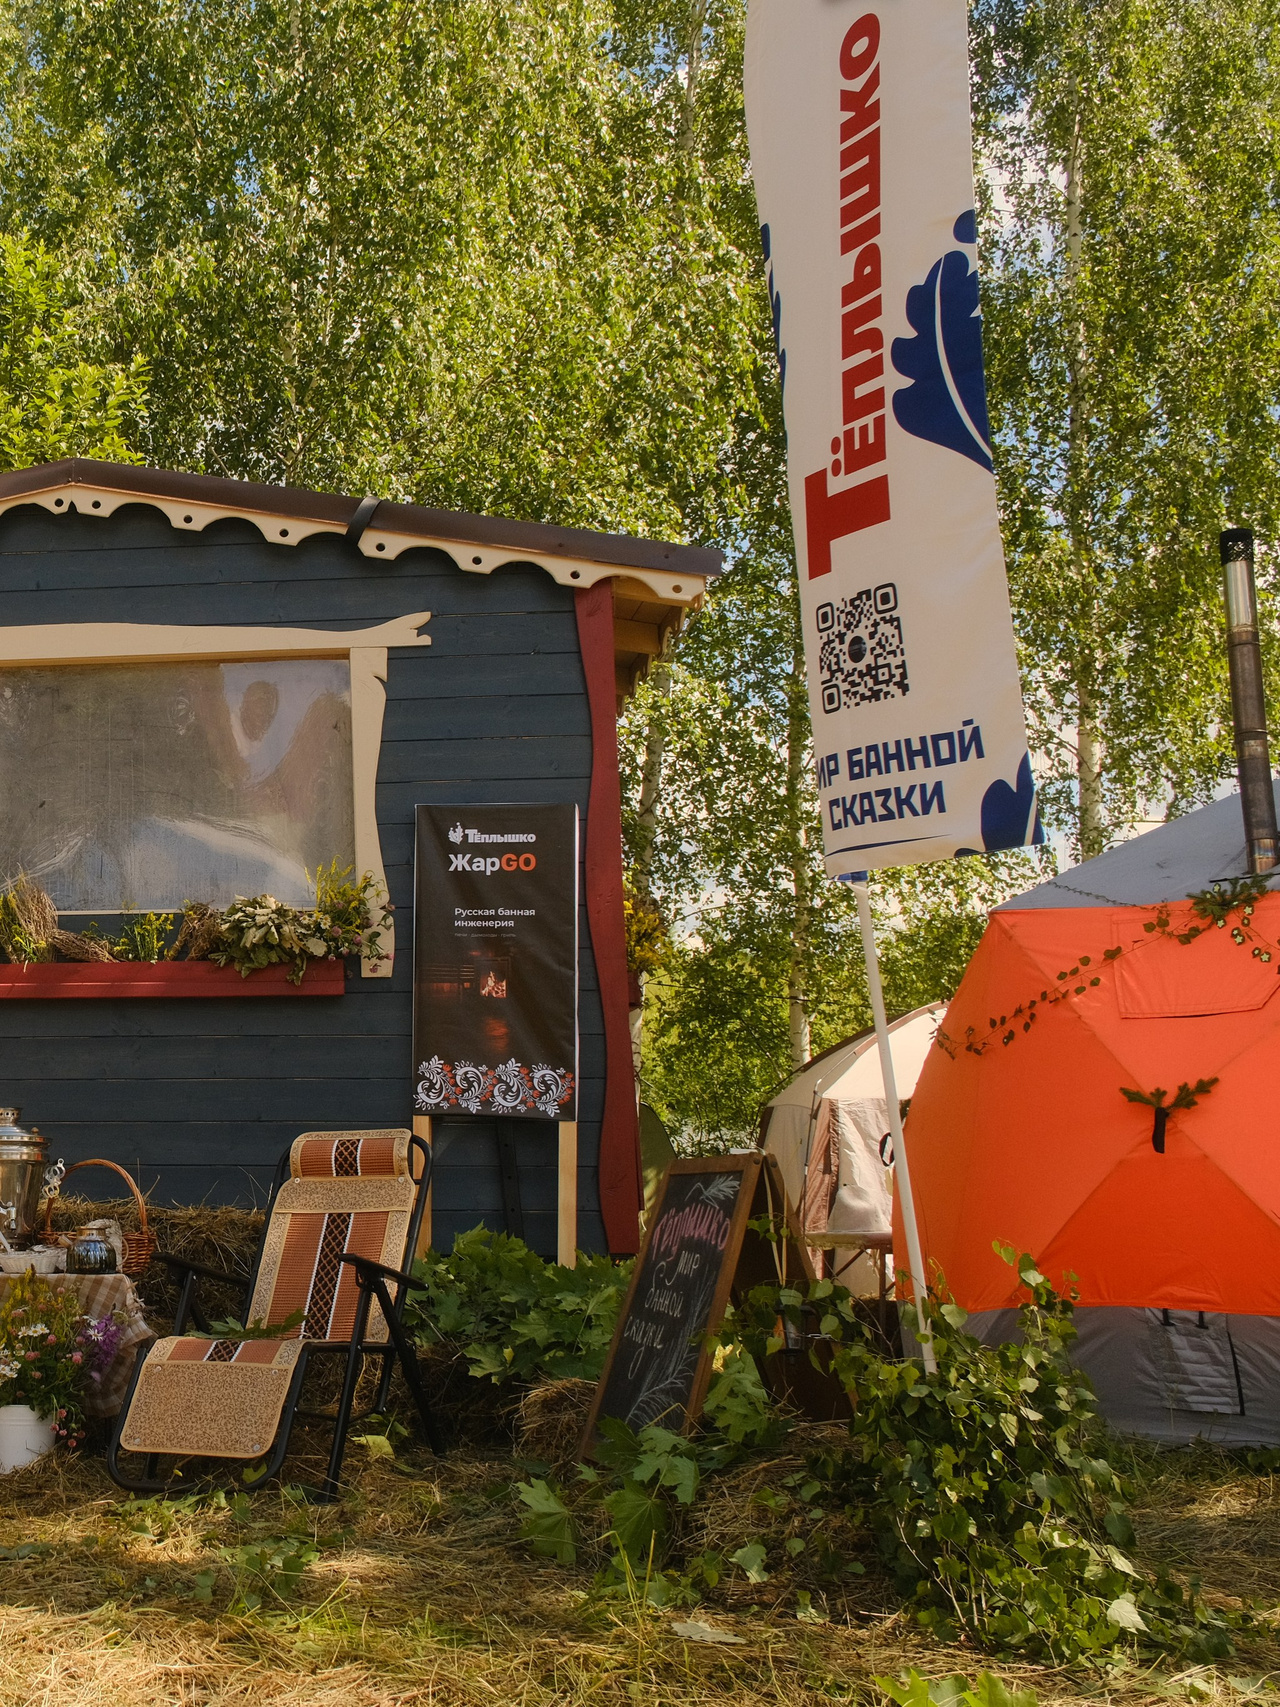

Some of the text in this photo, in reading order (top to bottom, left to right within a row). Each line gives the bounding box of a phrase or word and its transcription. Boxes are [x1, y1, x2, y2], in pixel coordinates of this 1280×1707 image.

[815, 719, 986, 791] ИР БАННОЙ
[829, 780, 947, 831] СКАЗКИ
[448, 853, 537, 876] ЖарGO
[454, 907, 536, 918] Русская банная
[454, 920, 515, 929] инженерия
